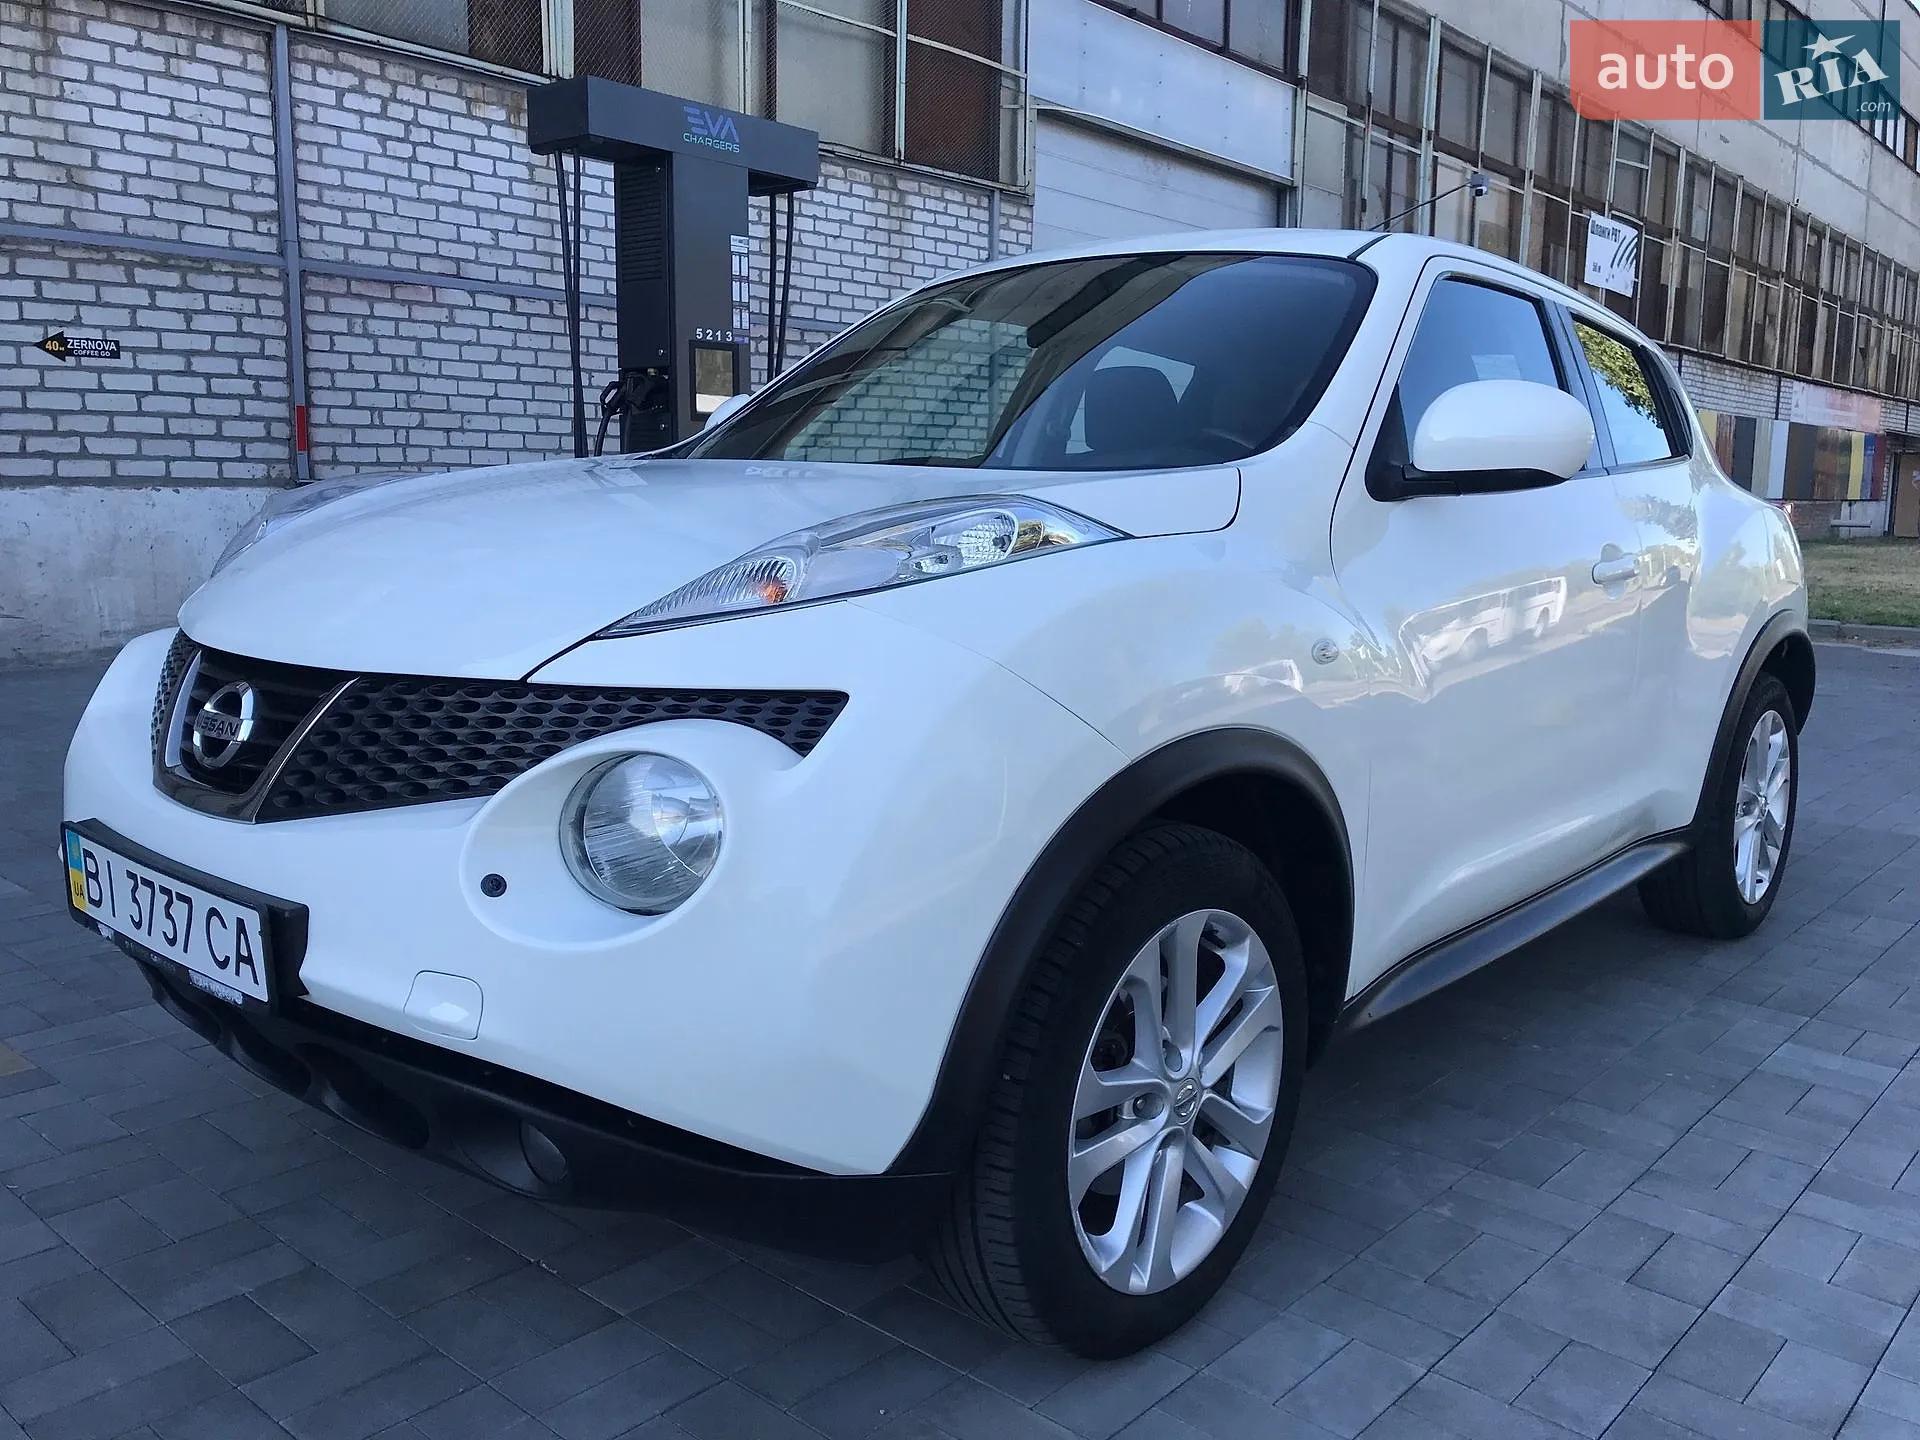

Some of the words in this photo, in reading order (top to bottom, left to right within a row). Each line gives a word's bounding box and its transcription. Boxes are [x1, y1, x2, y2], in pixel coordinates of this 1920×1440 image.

[683, 132, 740, 153] CHARGERS
[696, 328, 732, 342] 5213
[66, 339, 117, 351] ZERNOVA
[73, 349, 100, 357] COFFEE
[74, 880, 85, 899] UA
[82, 847, 117, 918] BI
[126, 869, 193, 954] 3737
[205, 906, 259, 986] CA
